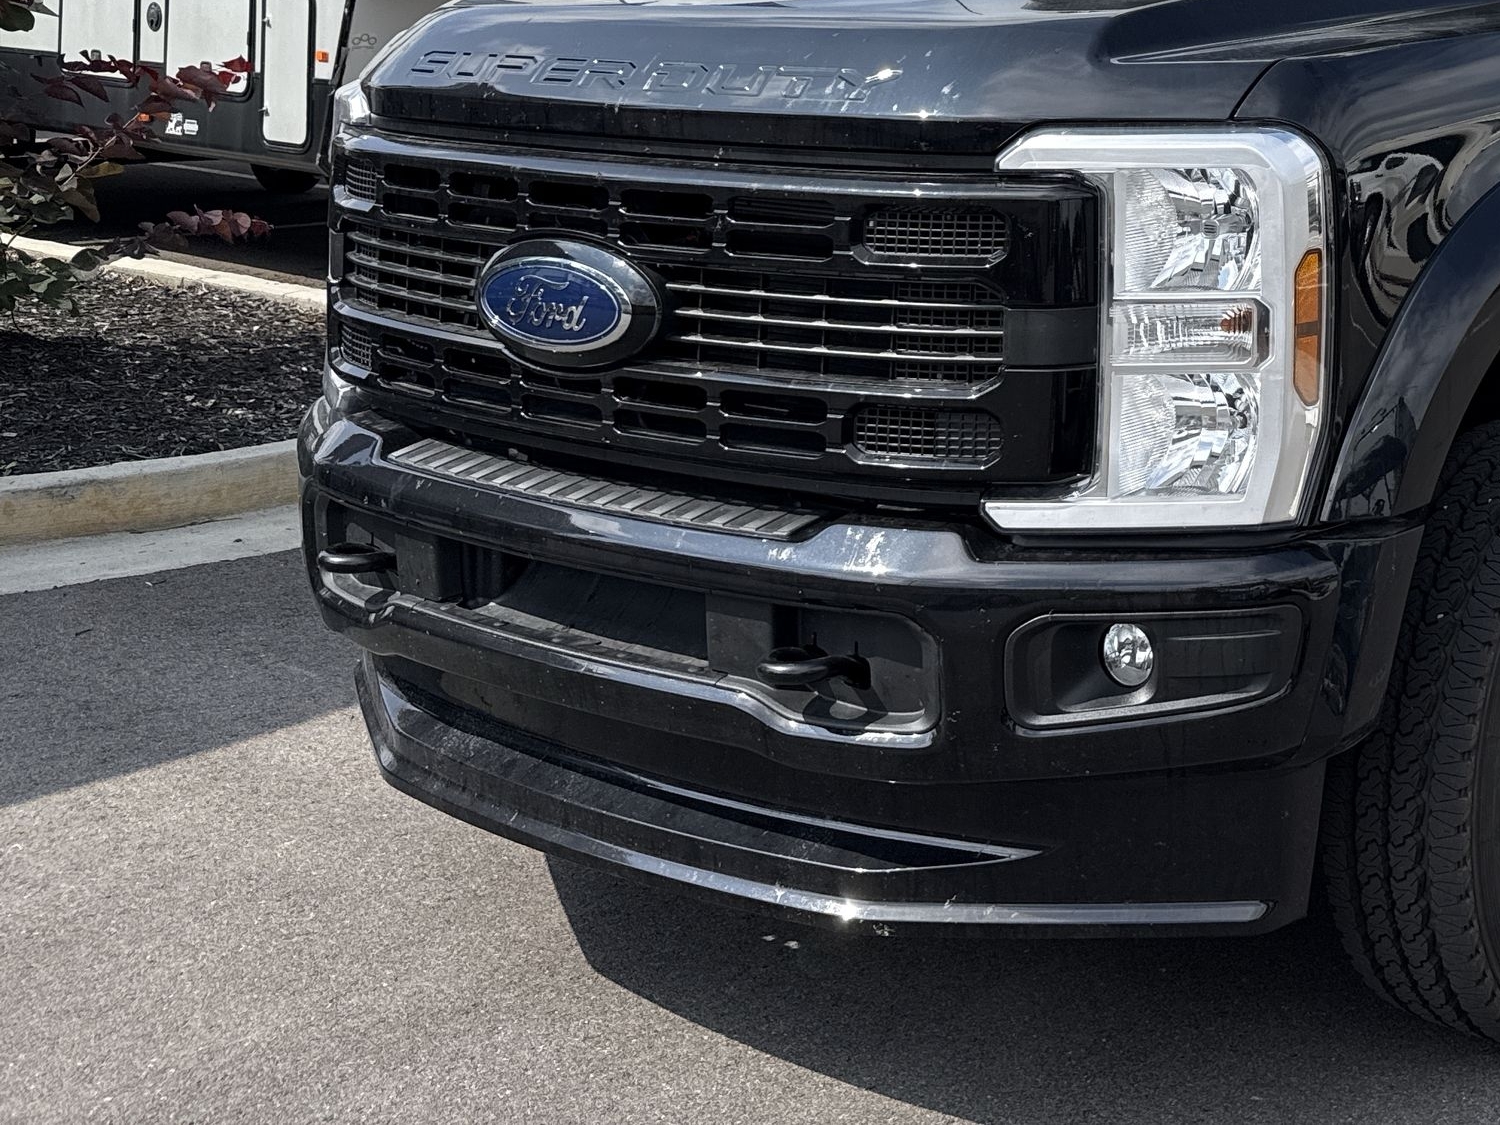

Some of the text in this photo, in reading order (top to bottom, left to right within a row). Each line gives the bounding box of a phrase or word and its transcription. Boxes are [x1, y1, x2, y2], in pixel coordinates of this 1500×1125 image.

[410, 49, 903, 103] SUPER DUTY
[505, 274, 590, 332] Ford
